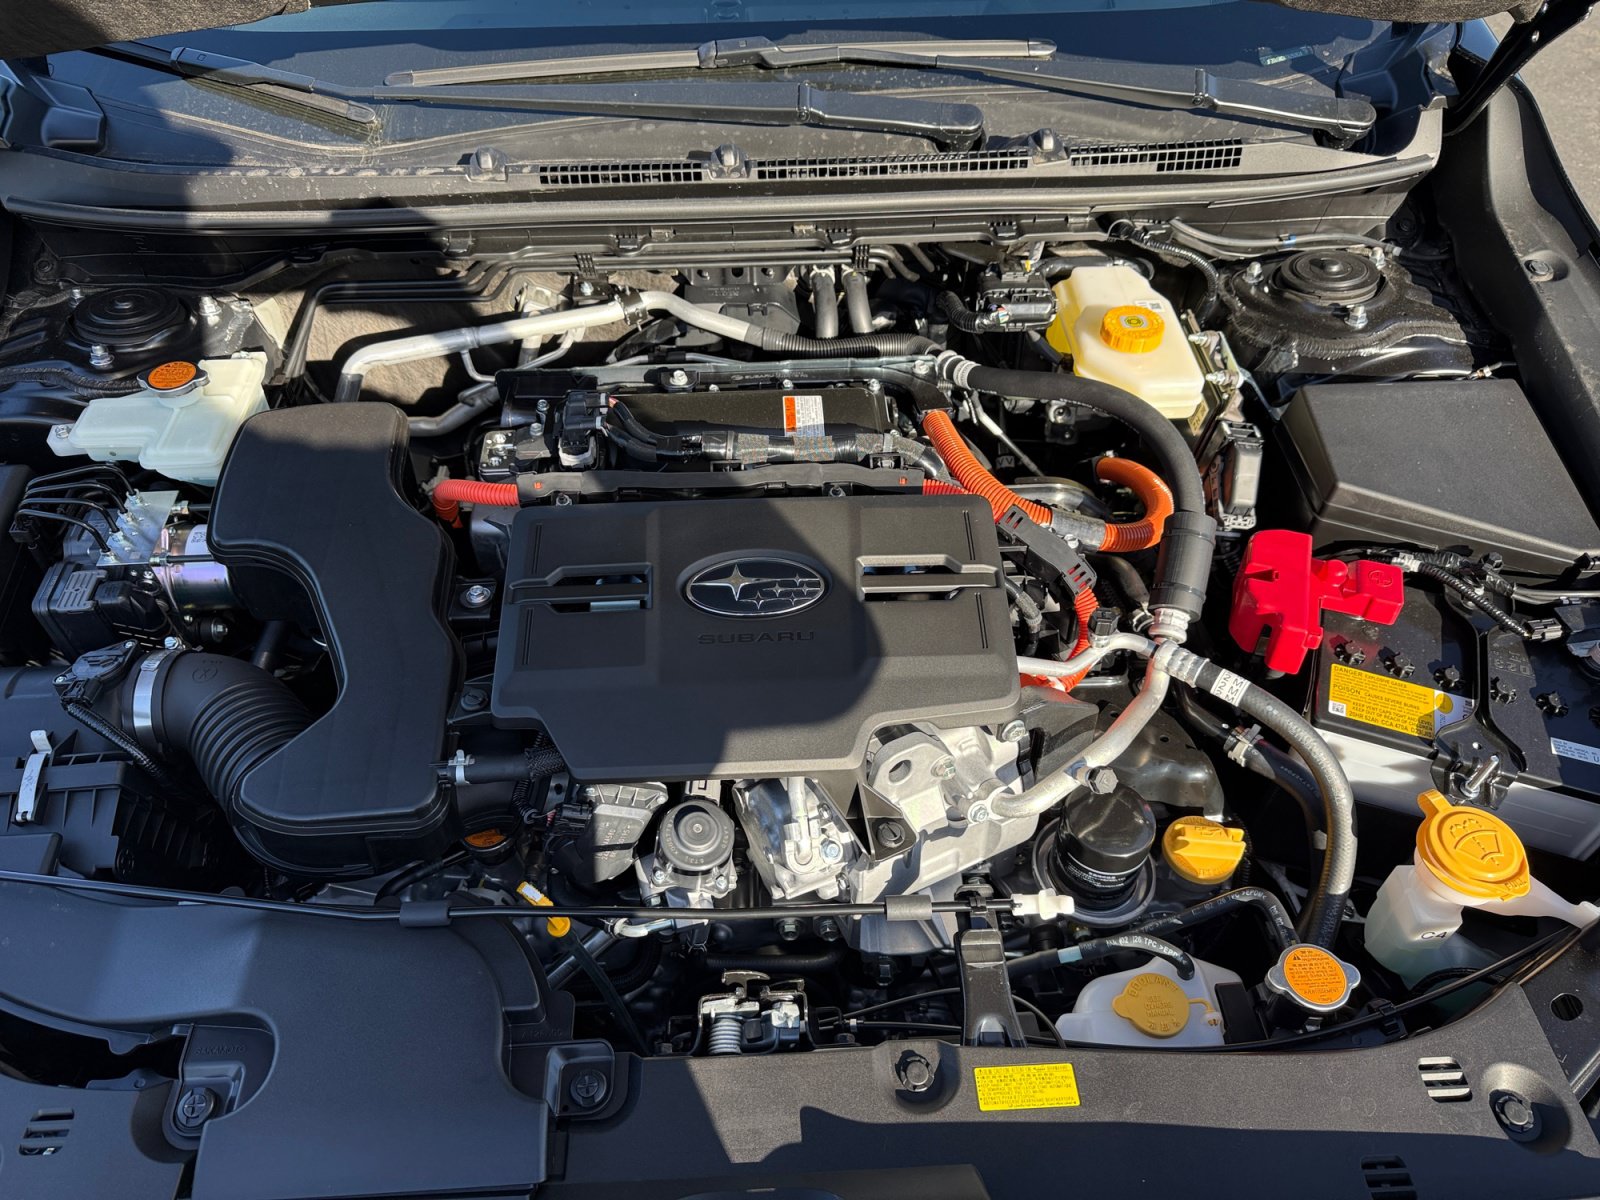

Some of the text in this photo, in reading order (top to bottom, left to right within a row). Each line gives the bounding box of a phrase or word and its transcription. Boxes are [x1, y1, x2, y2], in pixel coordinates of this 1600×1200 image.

[698, 631, 815, 645] SUBARU
[1334, 665, 1363, 677] DANGER
[1364, 673, 1390, 685] EXPLOSIVE
[1218, 681, 1239, 697] 2 M
[1233, 678, 1244, 688] M
[1333, 683, 1361, 696] POISON
[1352, 706, 1365, 714] KEEP
[1367, 704, 1379, 712] VENT
[1421, 931, 1447, 940] C4
[1144, 937, 1158, 948] TPC
[1128, 976, 1178, 997] COOLANT
